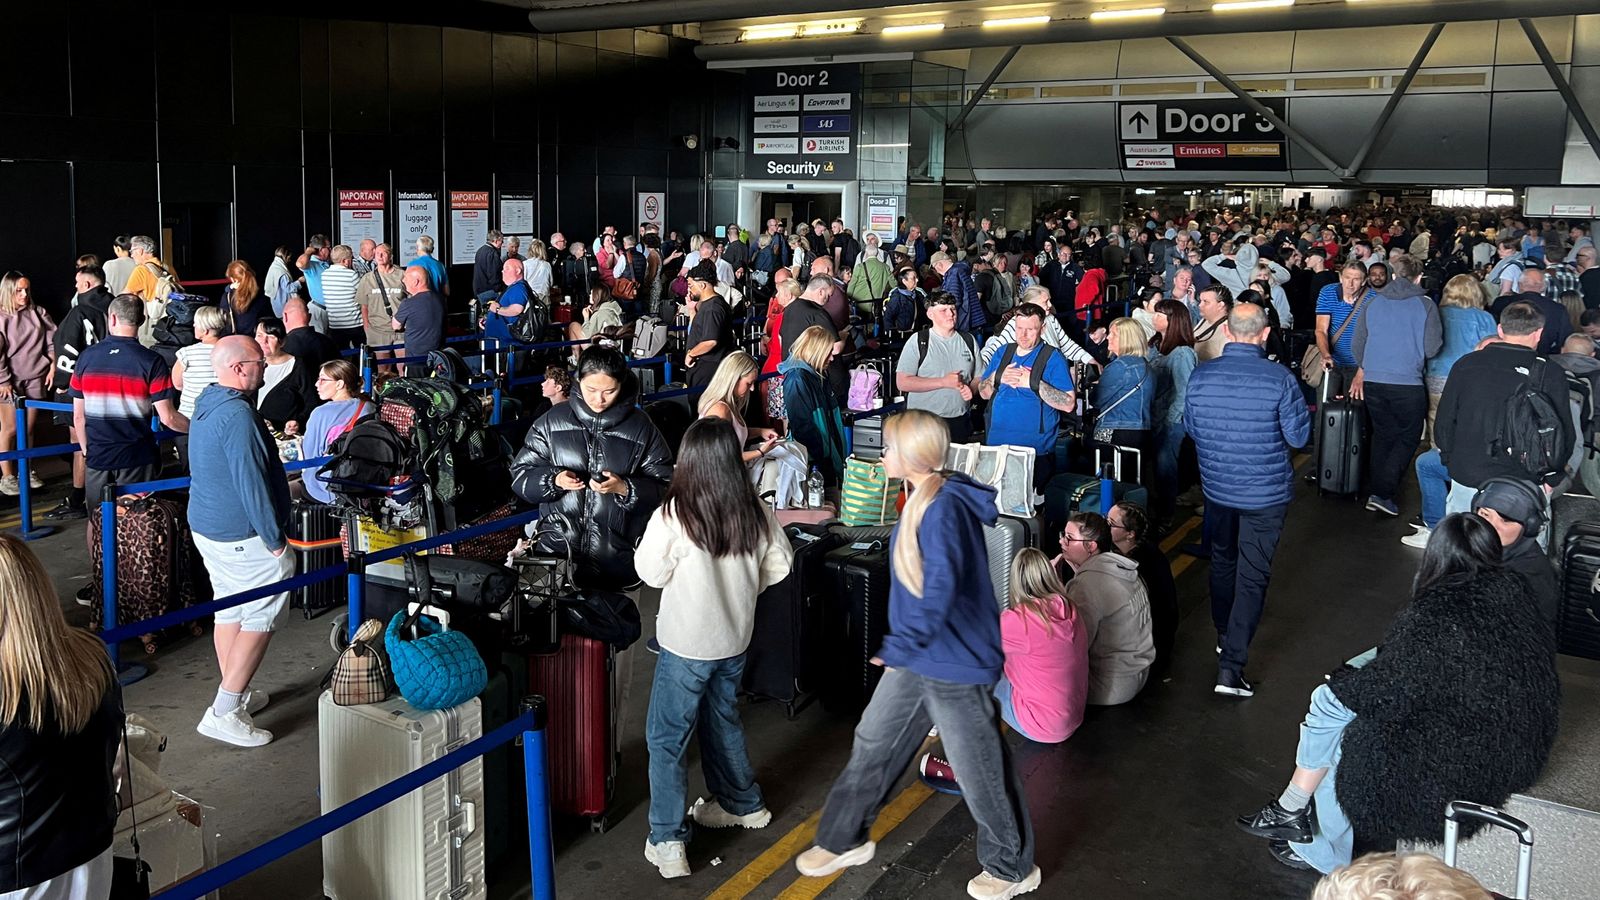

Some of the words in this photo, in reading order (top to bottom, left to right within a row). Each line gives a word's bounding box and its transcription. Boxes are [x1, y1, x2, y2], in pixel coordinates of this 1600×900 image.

[776, 72, 815, 87] Door
[819, 70, 829, 86] 2
[767, 100, 787, 109] Lingus
[817, 119, 834, 128] SAS
[1165, 108, 1246, 133] Door
[1255, 107, 1275, 133] 3
[1179, 146, 1221, 155] Emirates
[767, 160, 820, 177] Security
[340, 192, 384, 200] IMPORTANT
[398, 191, 432, 199] Information
[451, 193, 488, 201] IMPORTANT
[409, 203, 428, 211] Hand
[405, 214, 432, 223] luggage
[410, 225, 428, 234] only?
